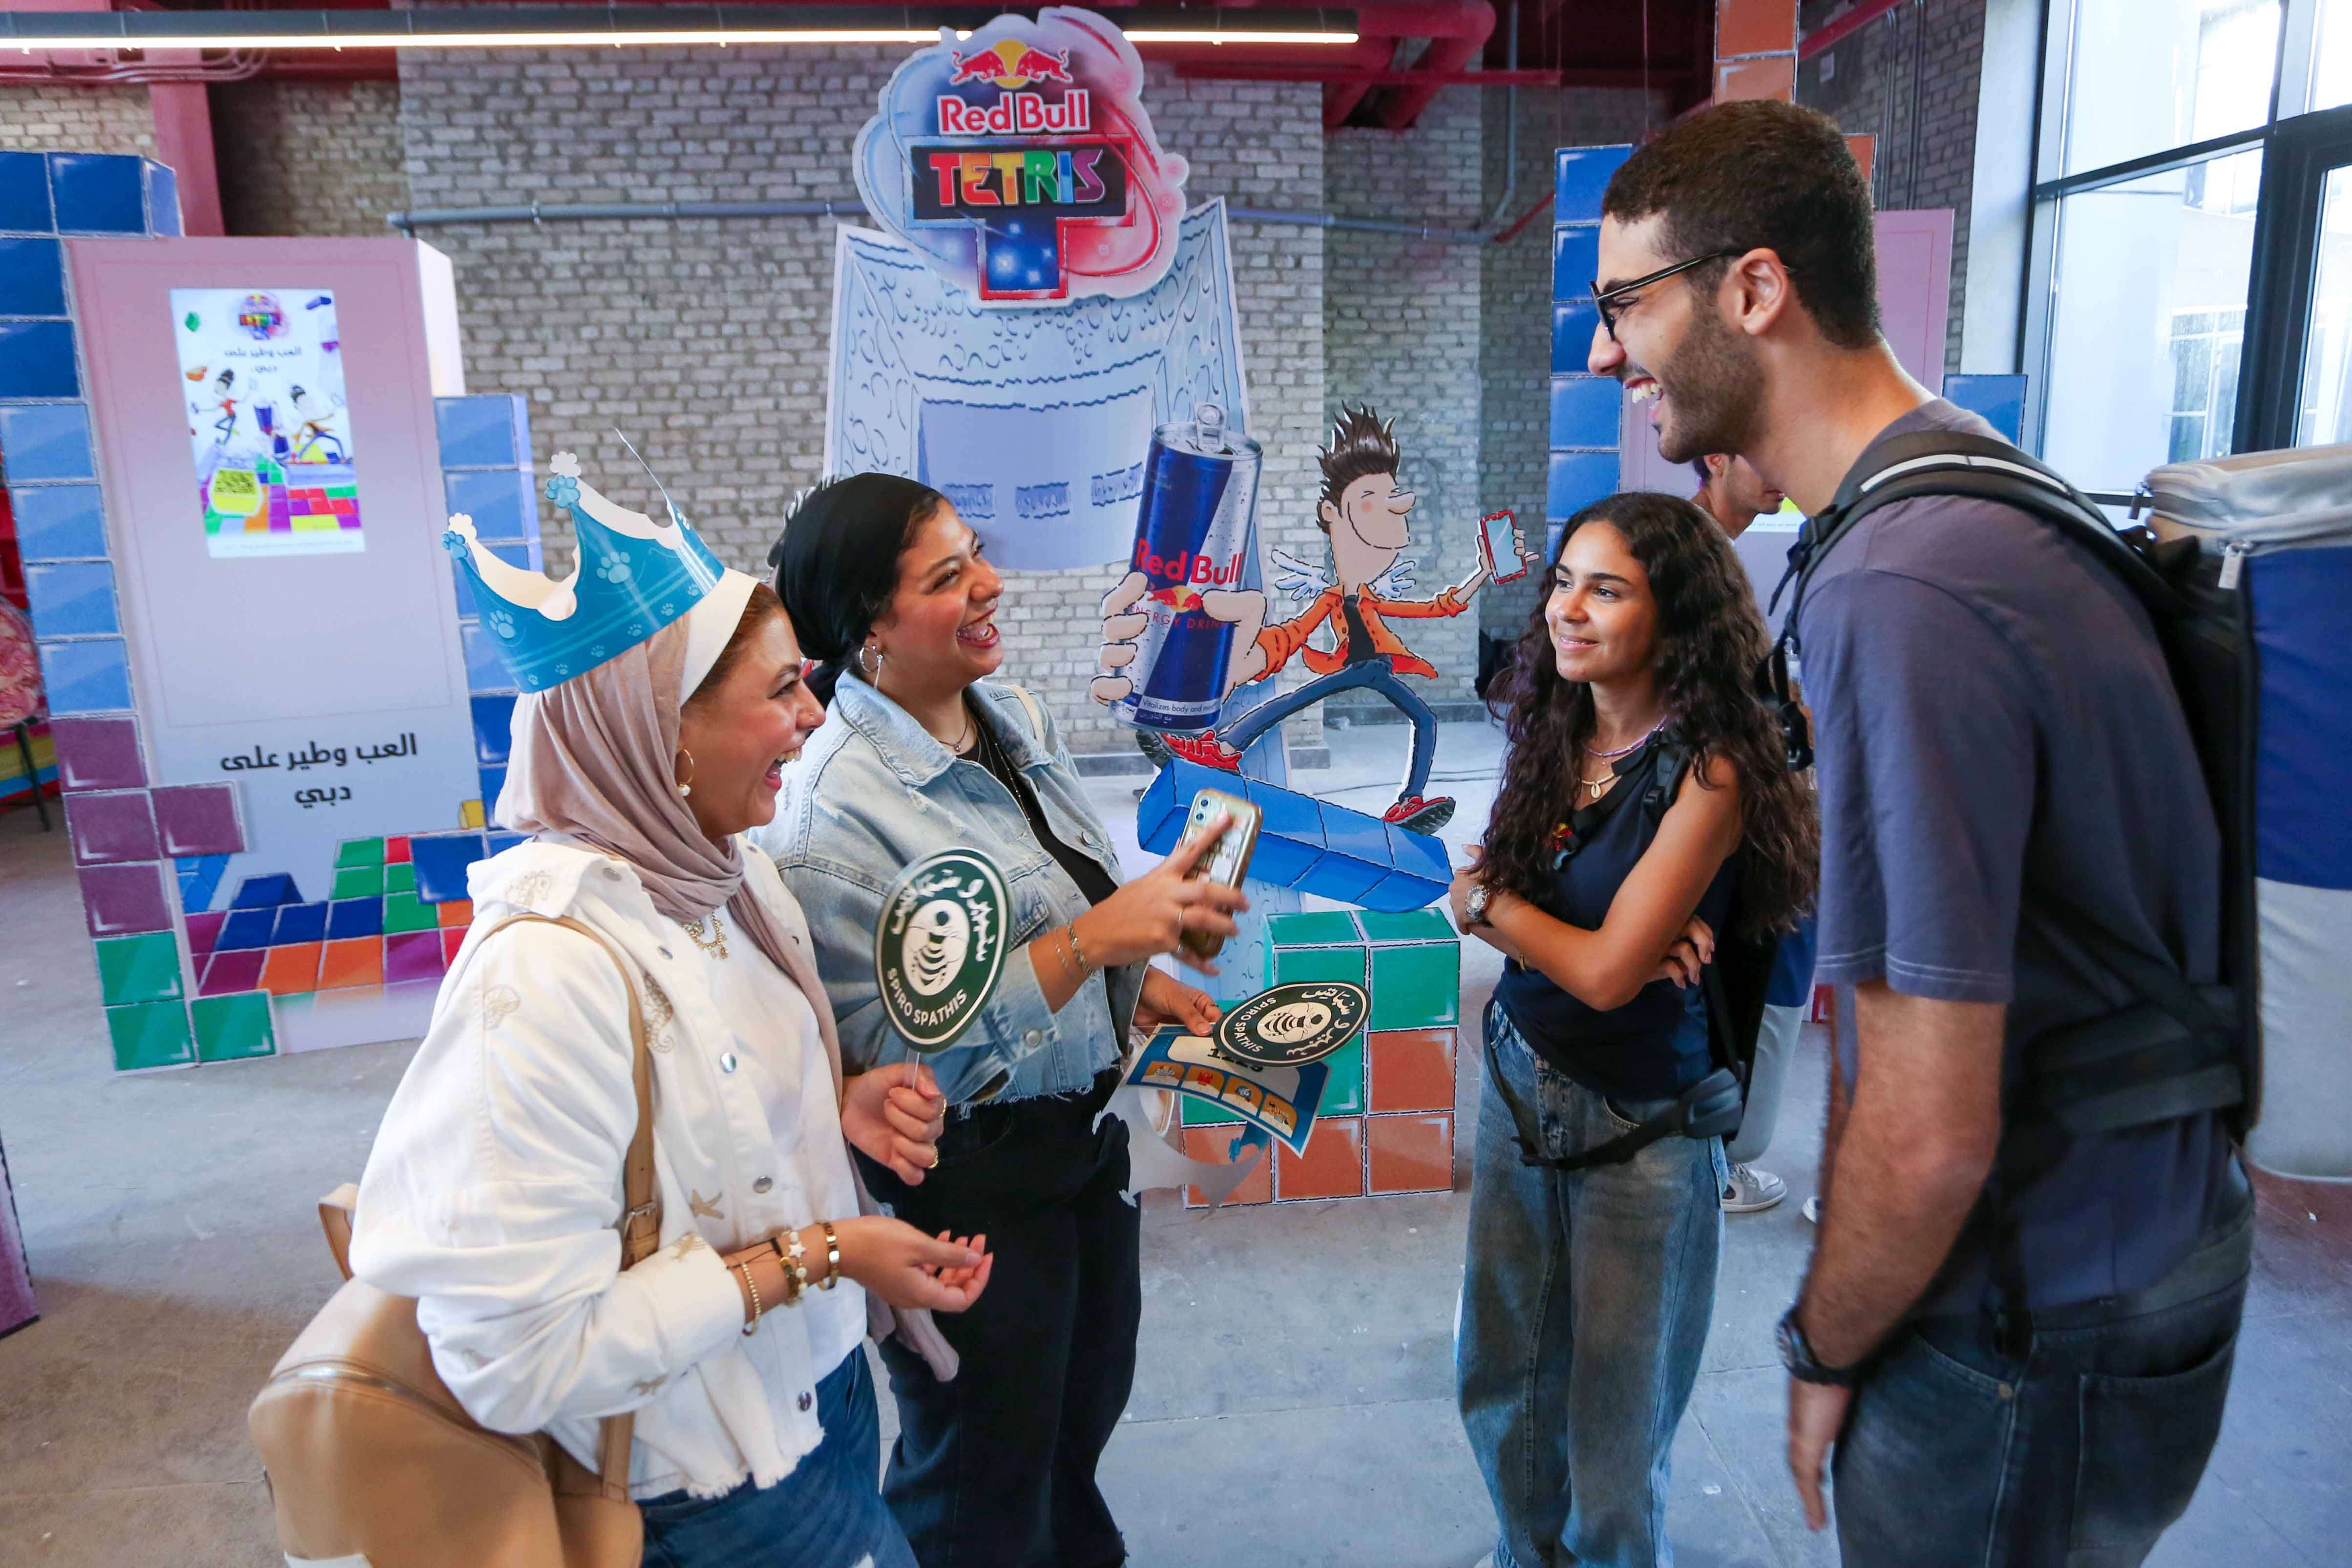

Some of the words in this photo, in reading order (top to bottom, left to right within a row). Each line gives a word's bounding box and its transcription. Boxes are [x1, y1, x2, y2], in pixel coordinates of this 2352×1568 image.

[939, 94, 1013, 133] Red
[1017, 91, 1088, 131] Bull
[929, 149, 1105, 207] TETRIS
[1135, 538, 1188, 581] Red
[1190, 552, 1244, 585] Bull
[1172, 703, 1189, 714] body
[221, 745, 280, 771] على
[287, 740, 347, 771] وطير
[356, 732, 417, 764] العب
[294, 786, 352, 809] دبي
[887, 967, 914, 1016] SPIRO
[913, 989, 967, 1027] SPATHIS
[1240, 997, 1277, 1021] SPIRO
[1234, 1022, 1263, 1052] SPATHIS
